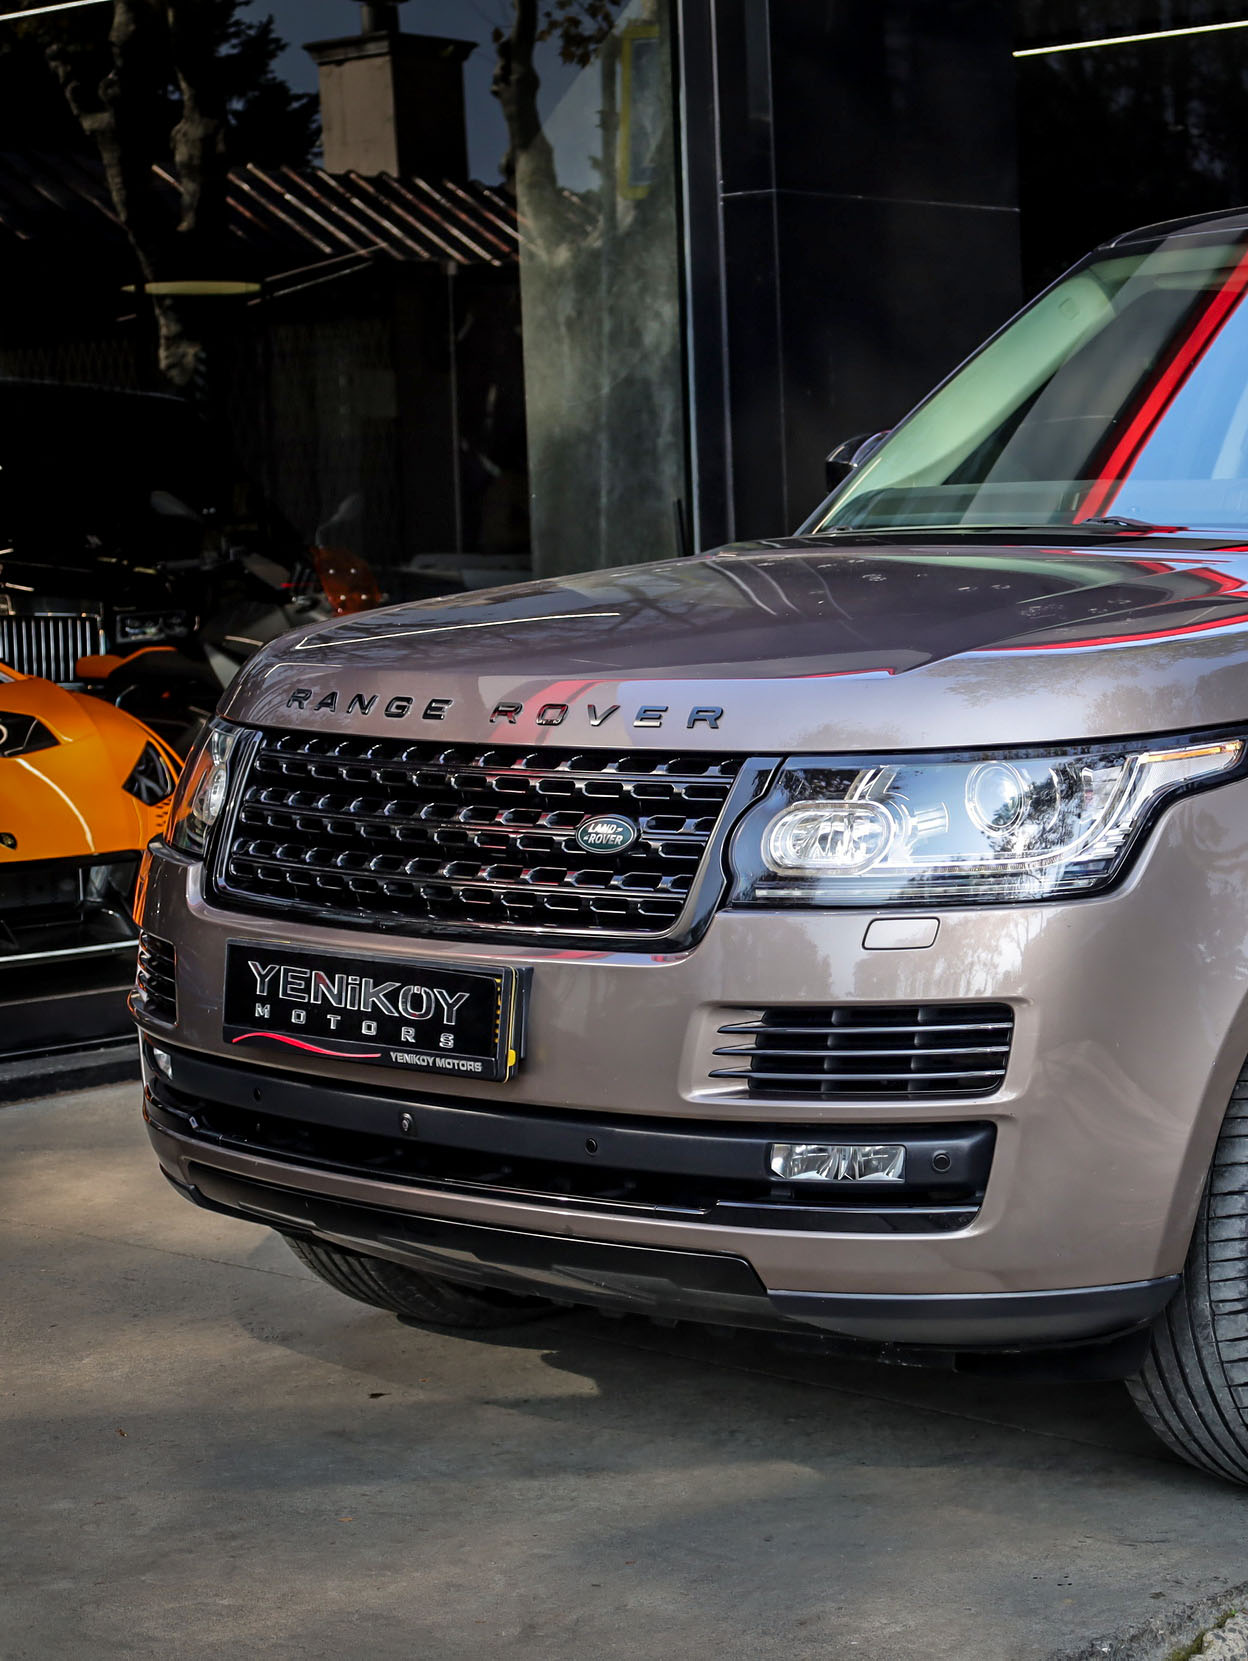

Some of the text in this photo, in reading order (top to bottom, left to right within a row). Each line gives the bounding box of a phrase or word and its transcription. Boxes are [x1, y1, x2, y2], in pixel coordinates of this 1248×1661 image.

[287, 688, 725, 730] RANGE ROVER
[588, 823, 617, 833] LAND
[588, 833, 623, 845] ROVER
[254, 1003, 455, 1049] MOTORS
[435, 1057, 483, 1073] MOTORS
